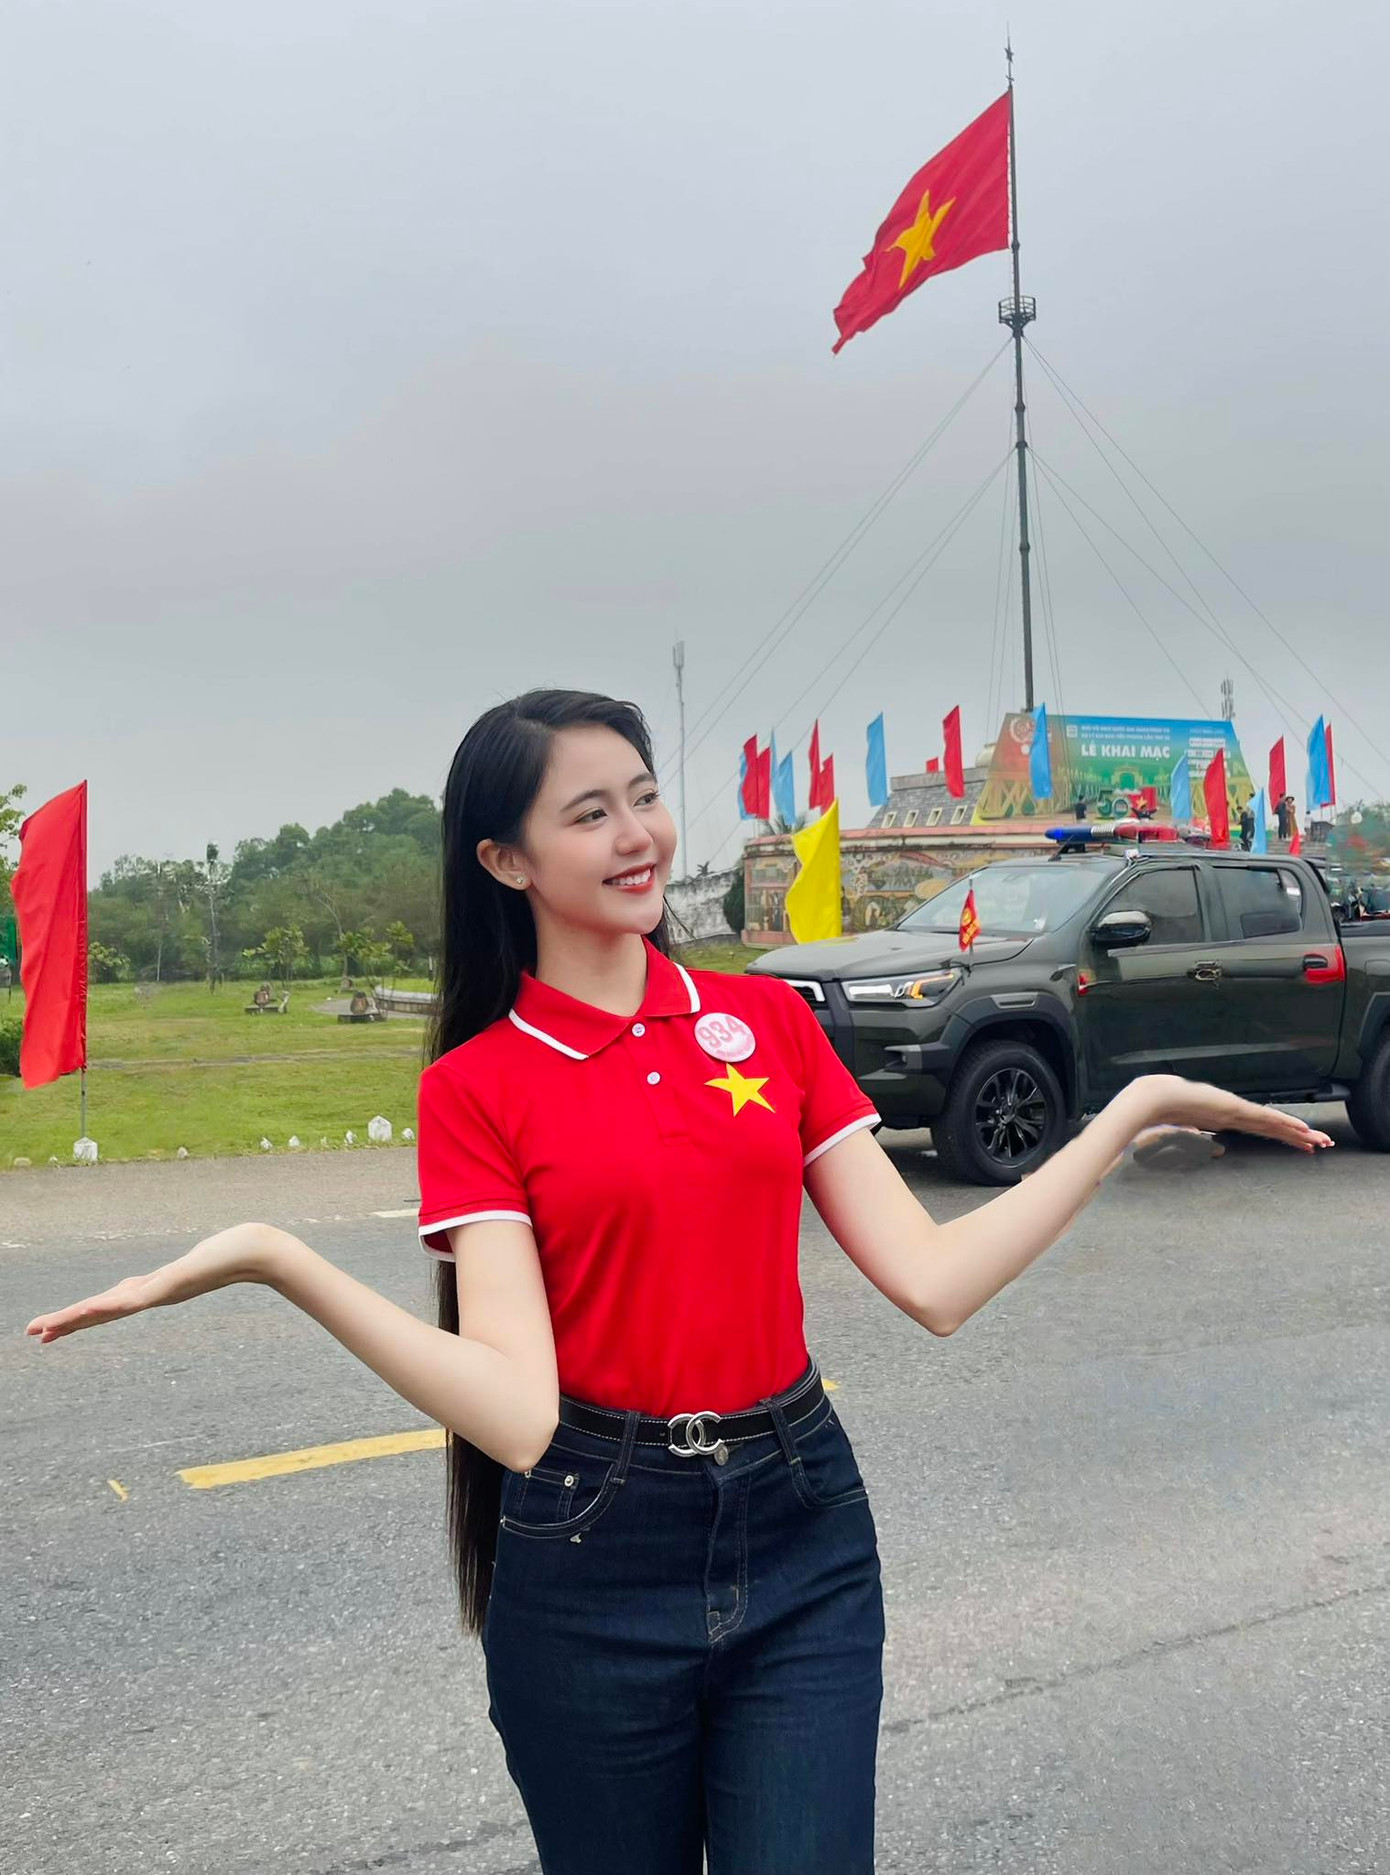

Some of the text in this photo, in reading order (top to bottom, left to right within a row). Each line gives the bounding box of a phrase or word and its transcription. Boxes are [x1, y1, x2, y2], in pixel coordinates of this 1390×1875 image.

[1101, 745, 1136, 758] KHAI
[1140, 745, 1171, 761] MẠC
[697, 1015, 746, 1049] 934
